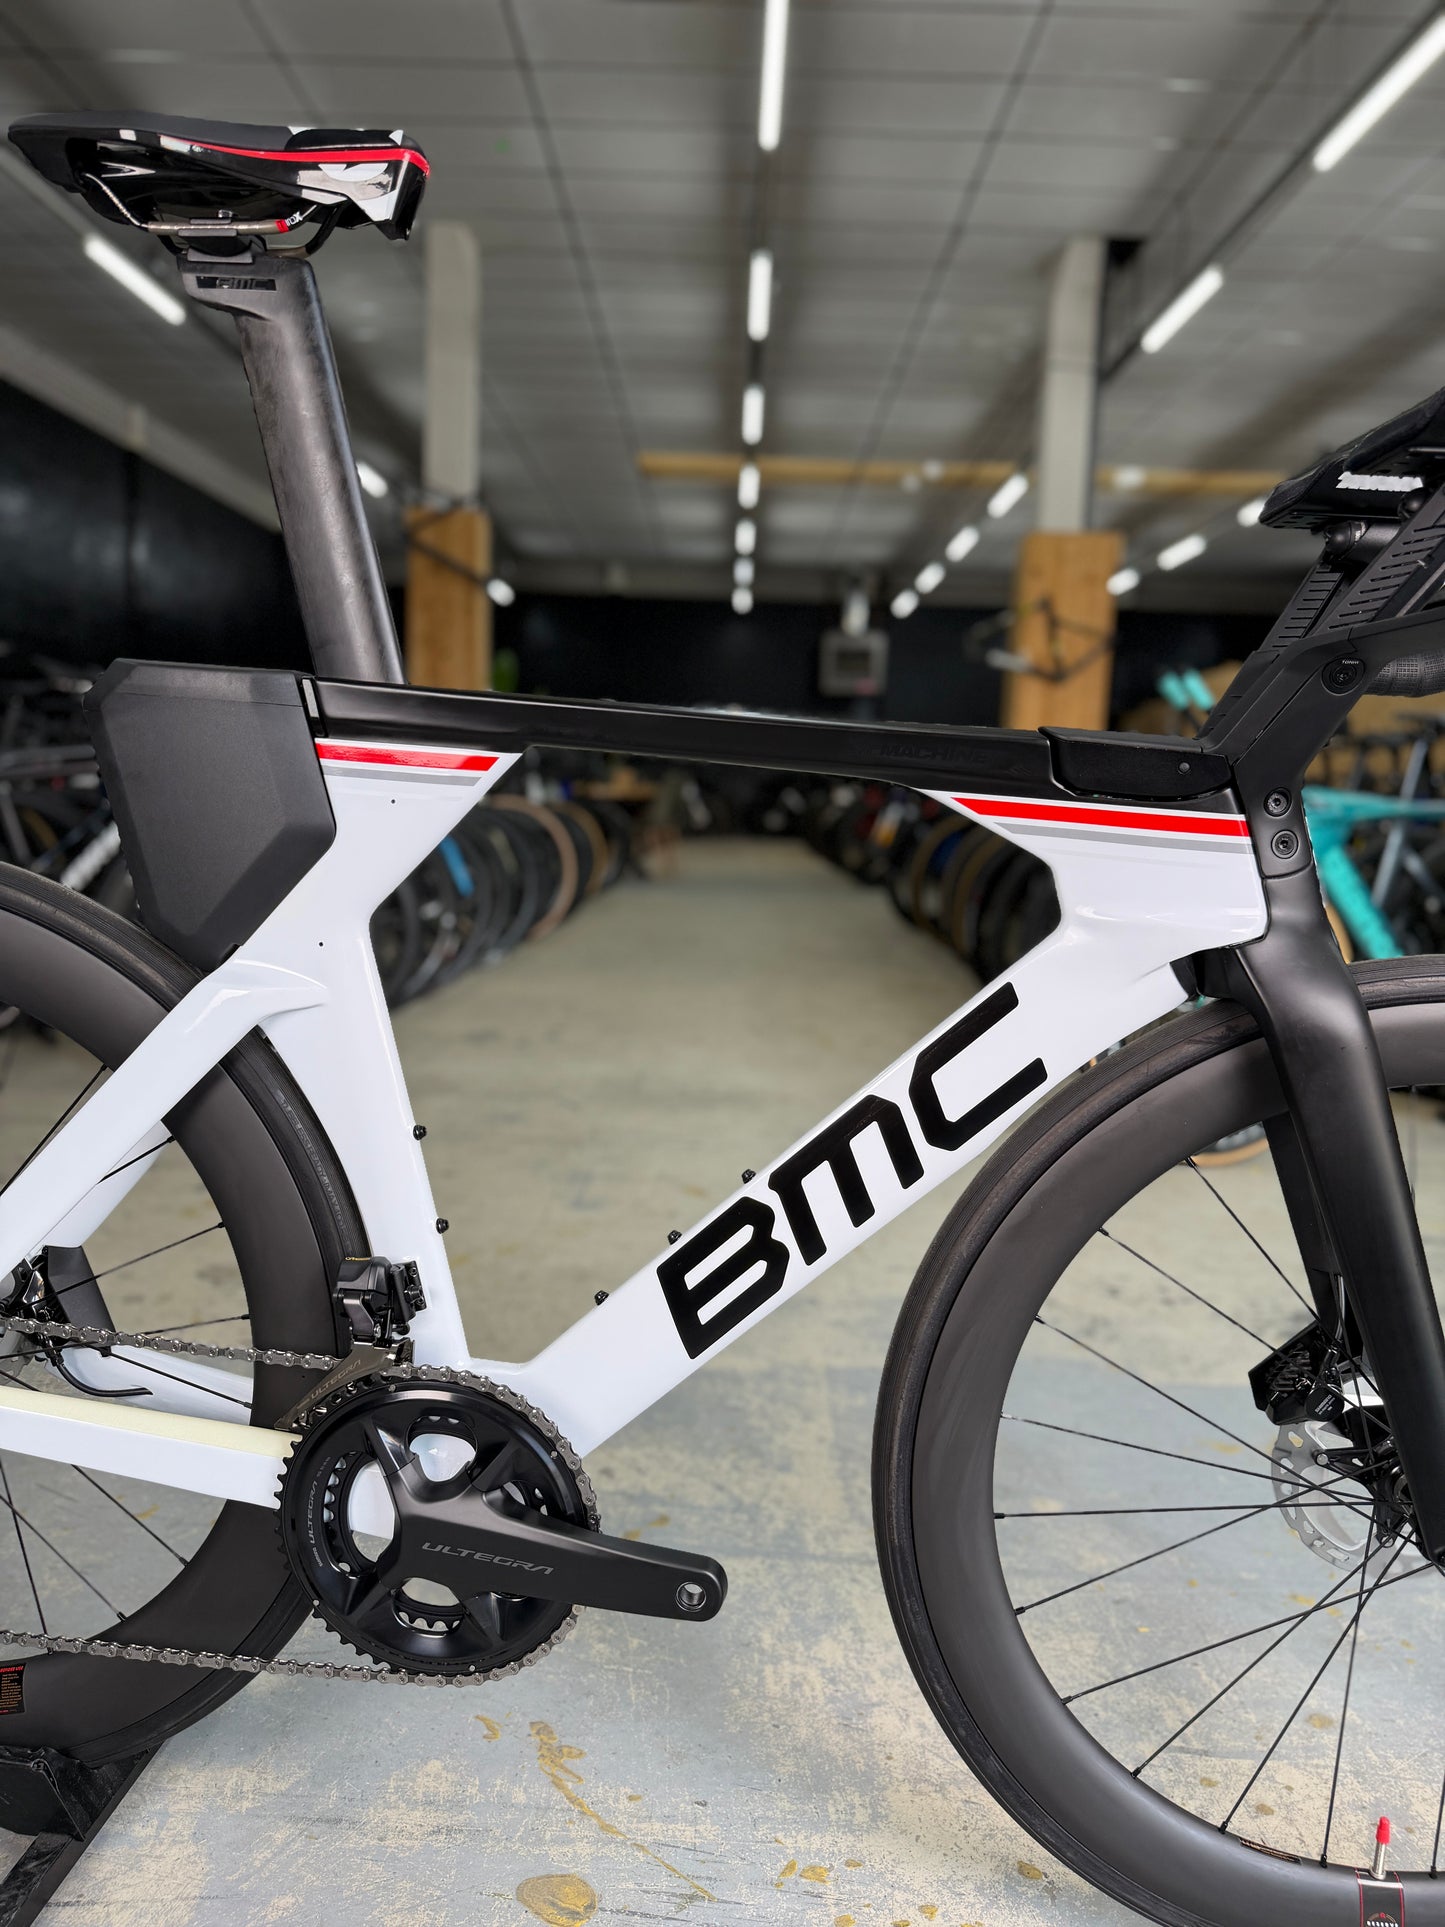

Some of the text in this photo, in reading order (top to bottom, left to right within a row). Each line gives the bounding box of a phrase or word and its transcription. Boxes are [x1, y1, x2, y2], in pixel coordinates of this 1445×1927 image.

[656, 981, 1048, 1360] BMC
[307, 1480, 318, 1544] ULTEGRA
[422, 1541, 554, 1575] ULTEGRA
